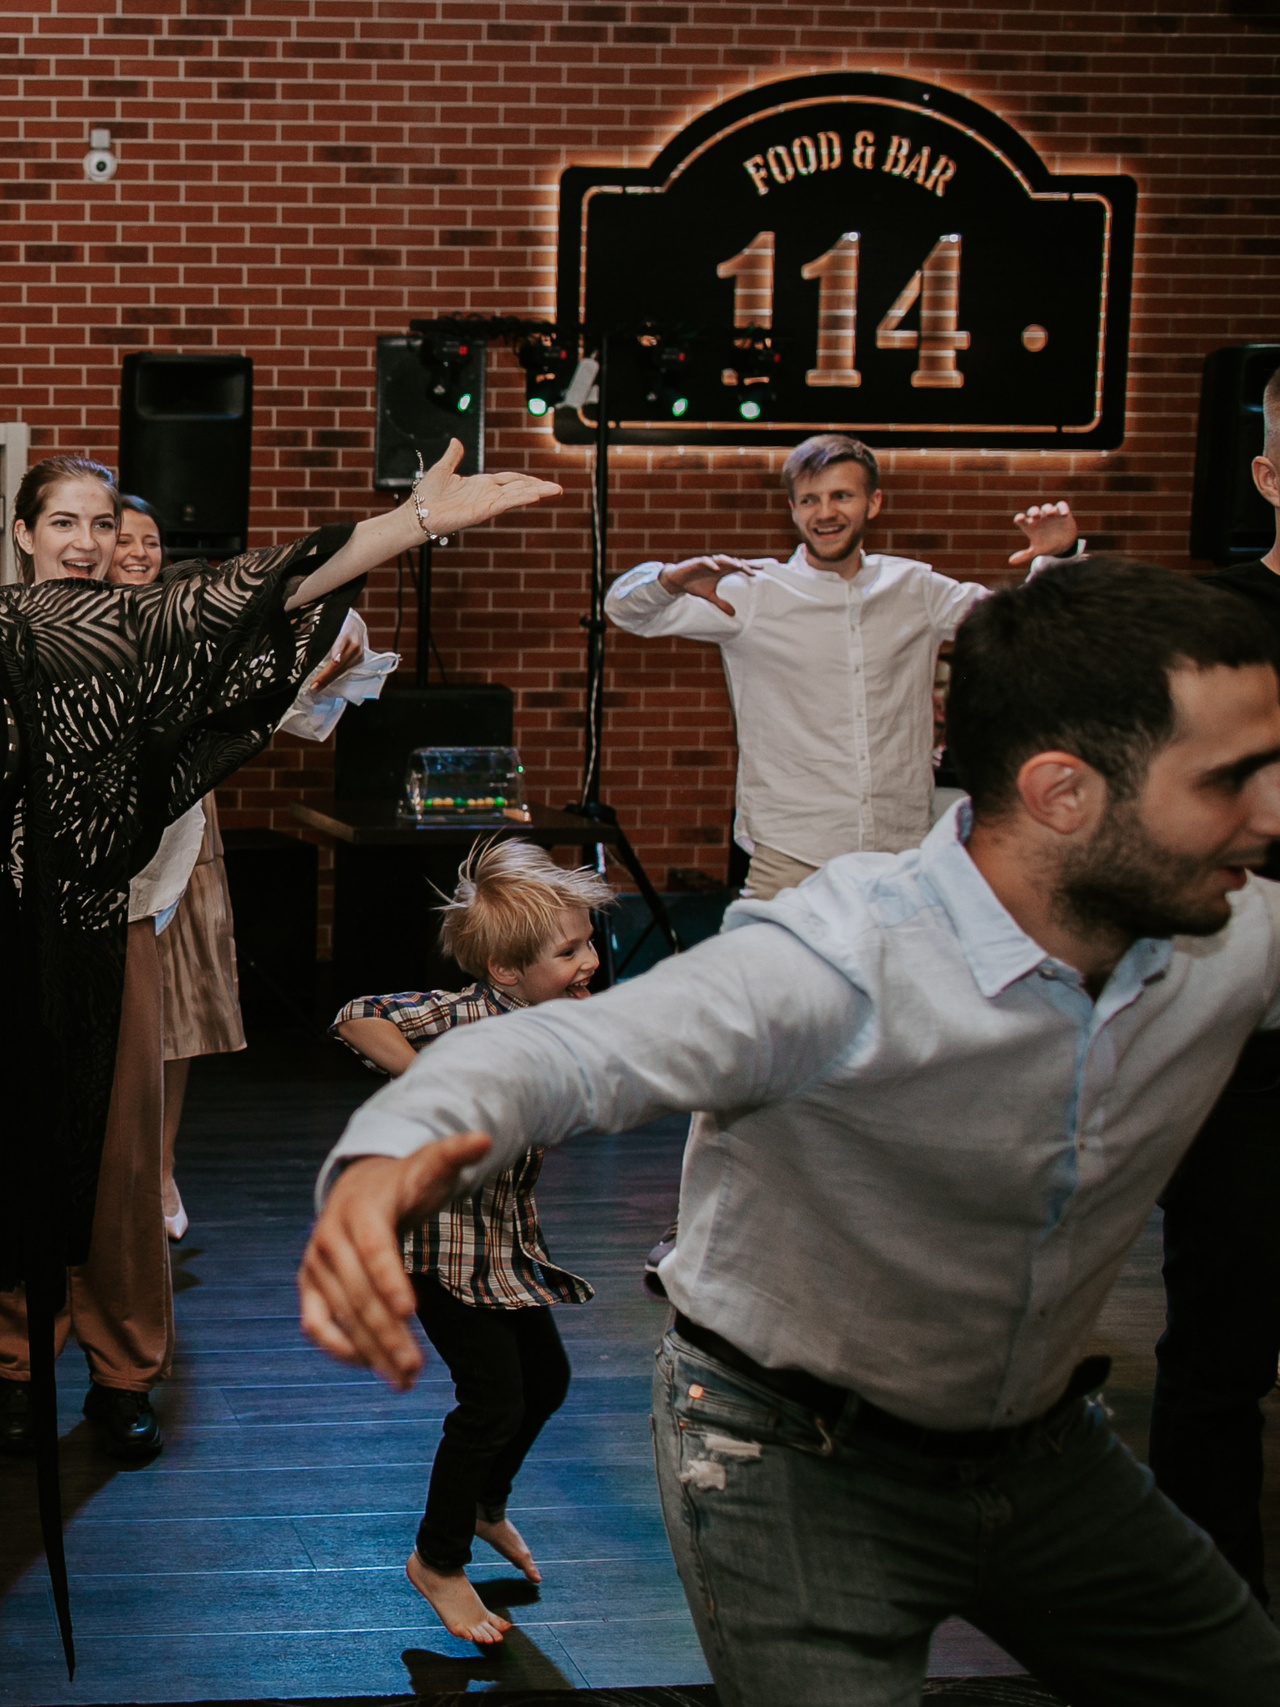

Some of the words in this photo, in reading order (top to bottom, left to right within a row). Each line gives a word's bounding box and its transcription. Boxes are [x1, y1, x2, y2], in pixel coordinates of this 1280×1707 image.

[742, 131, 842, 196] FOOD
[852, 130, 876, 169] &
[881, 135, 957, 197] BAR
[716, 231, 970, 388] 114
